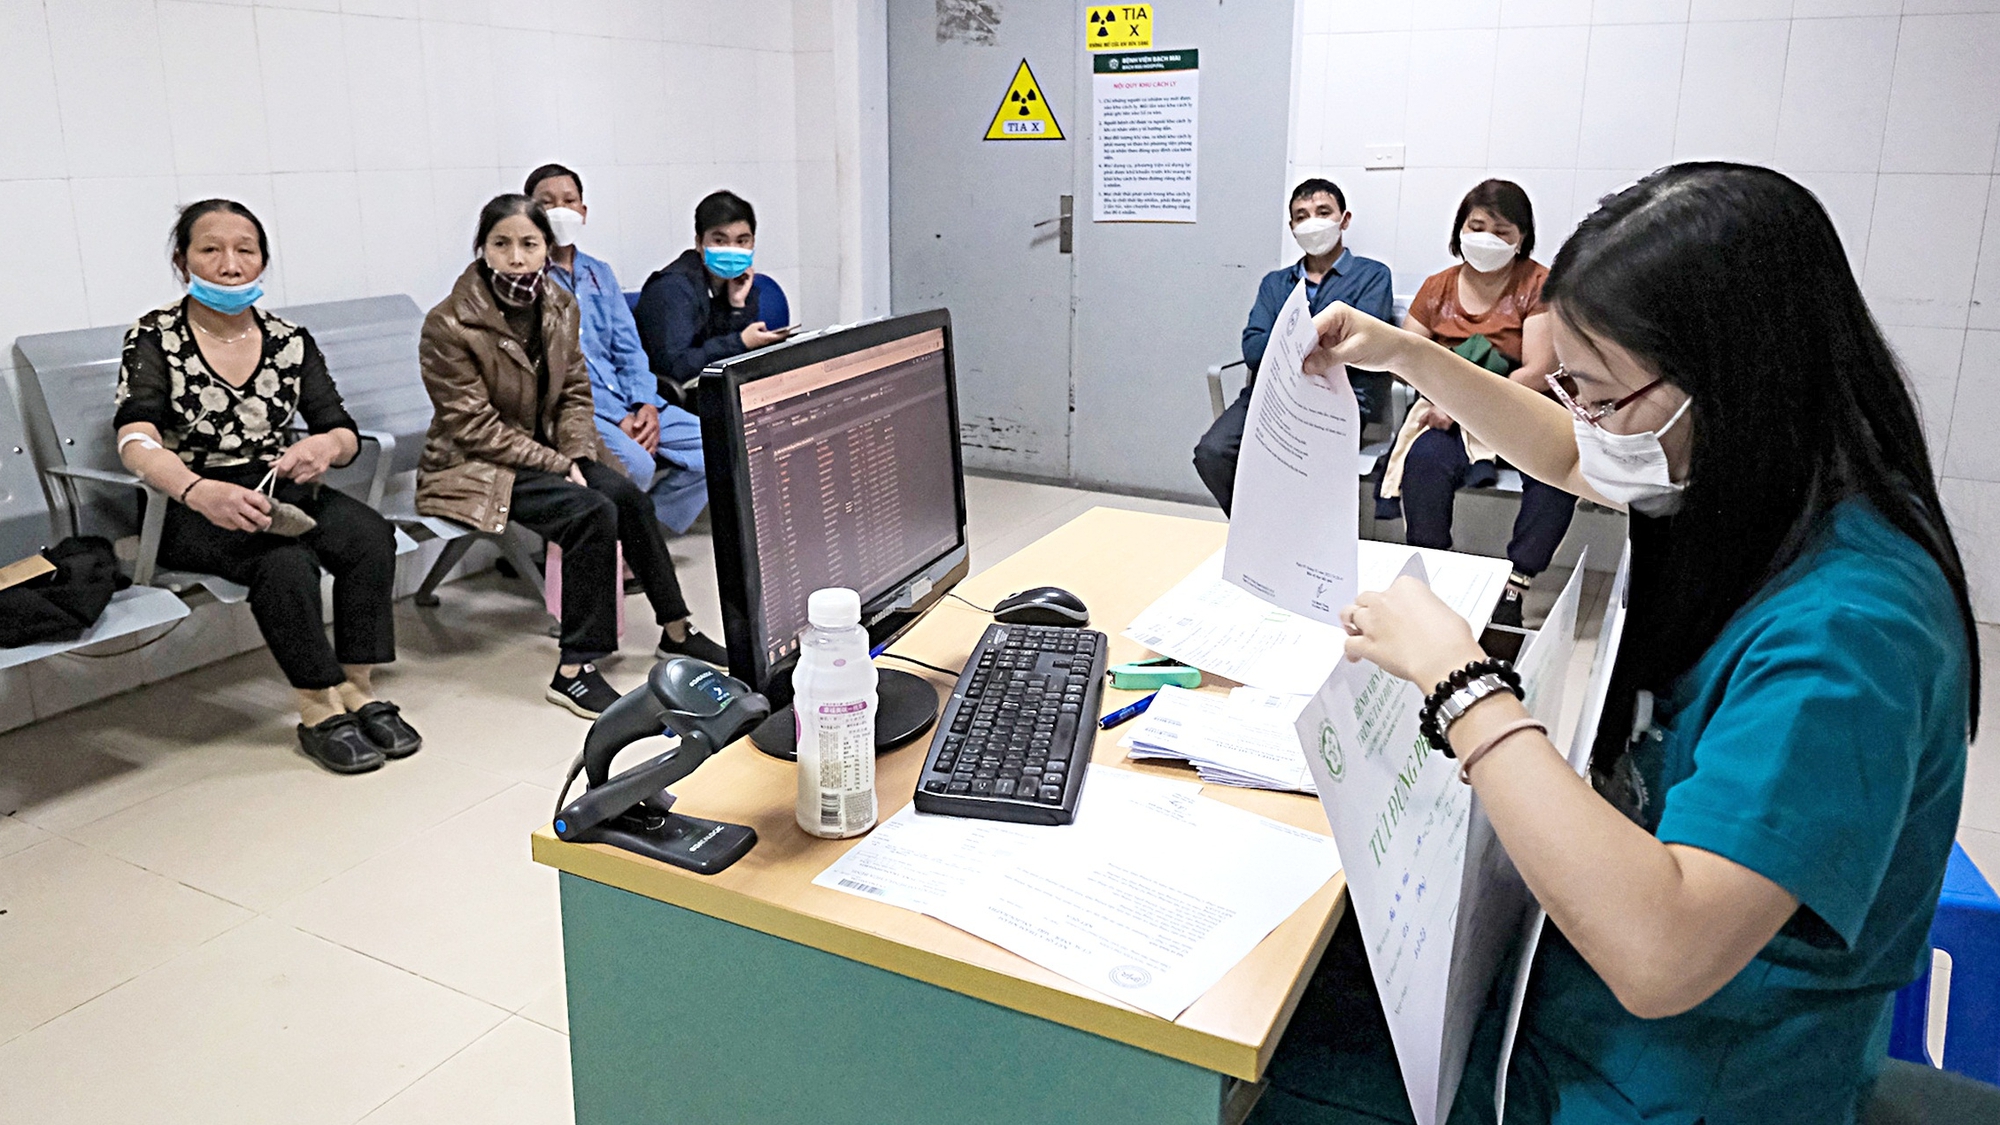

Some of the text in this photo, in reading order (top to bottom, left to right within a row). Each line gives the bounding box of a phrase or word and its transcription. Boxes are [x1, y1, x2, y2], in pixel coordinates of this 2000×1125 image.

[1122, 7, 1147, 20] TIA
[1130, 24, 1139, 37] X
[1007, 122, 1040, 132] TIA X
[871, 605, 896, 626] SAMSUNG
[1369, 812, 1392, 867] TÚI
[1388, 754, 1418, 827] ĐỰNG
